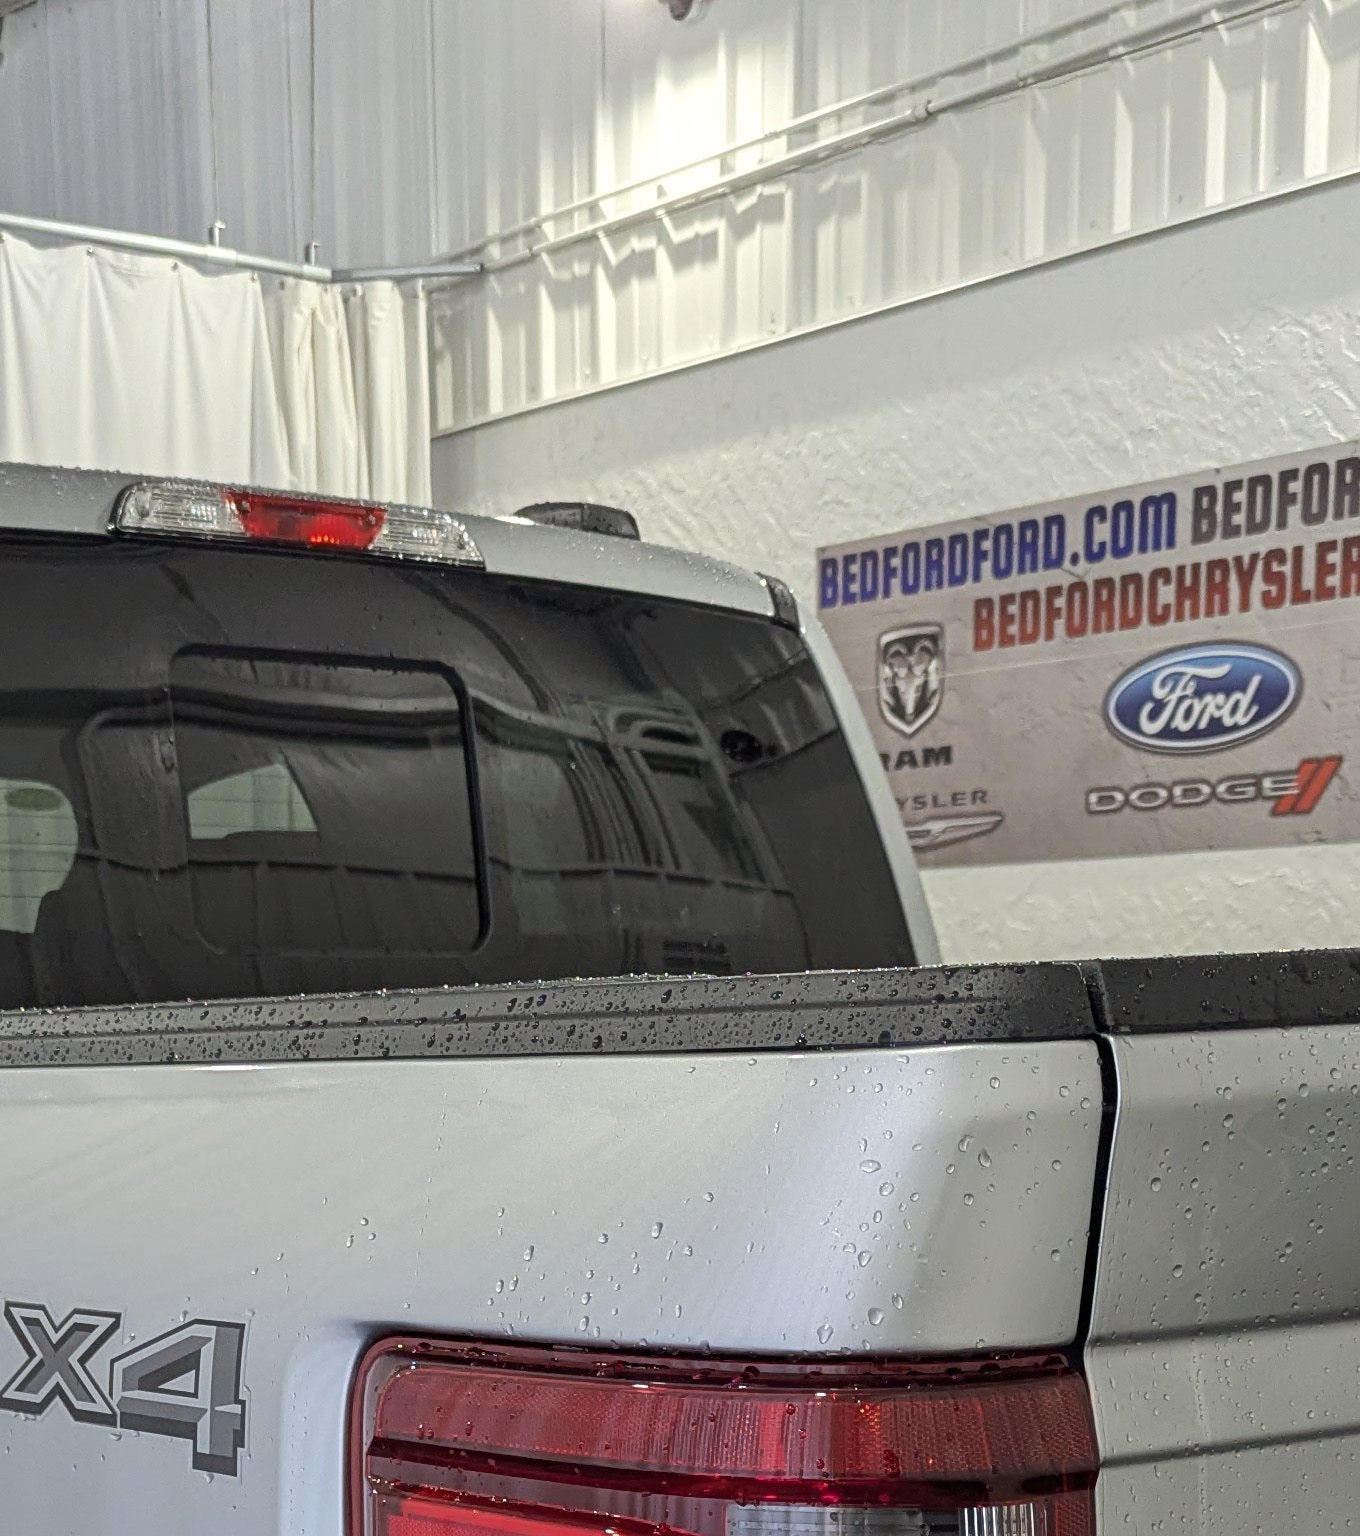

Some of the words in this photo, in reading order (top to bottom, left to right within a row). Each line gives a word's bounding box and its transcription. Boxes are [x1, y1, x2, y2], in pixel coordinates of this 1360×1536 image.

[819, 491, 1177, 609] BEDFORDFORD.COM
[1140, 664, 1263, 735] Ford
[1086, 770, 1300, 815] DODGE
